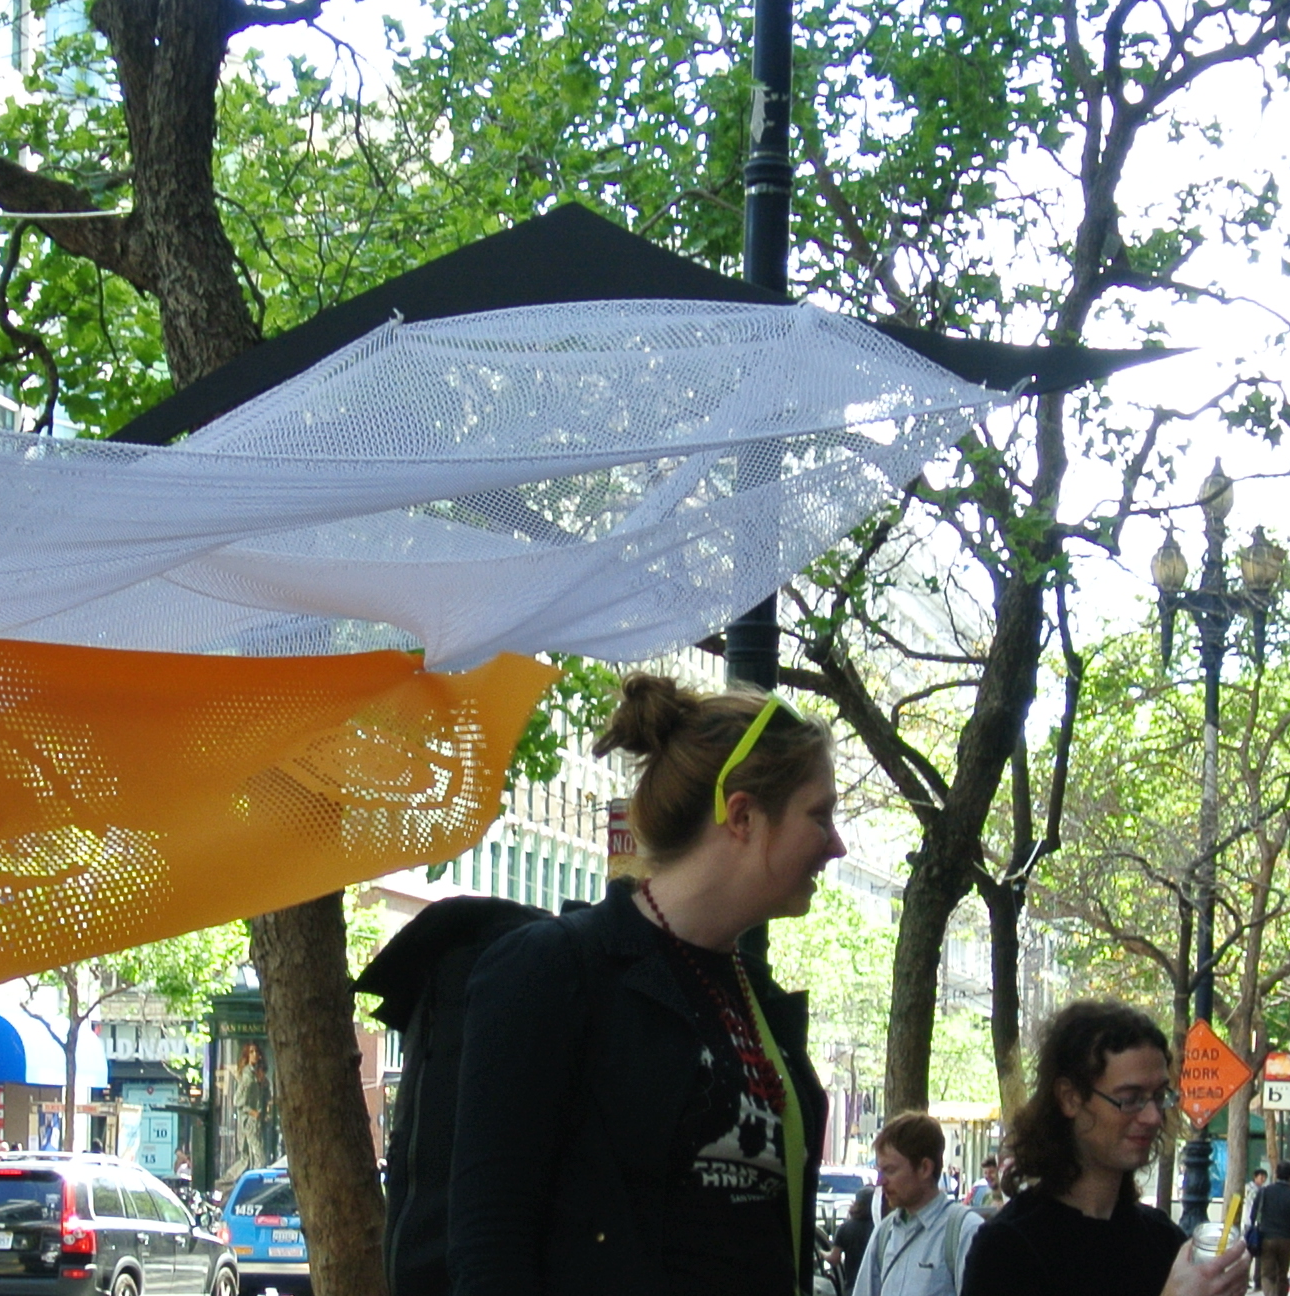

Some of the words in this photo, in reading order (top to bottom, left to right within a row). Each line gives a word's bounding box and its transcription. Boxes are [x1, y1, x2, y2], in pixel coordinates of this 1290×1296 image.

[613, 834, 633, 854] NO
[100, 1038, 134, 1062] LD
[137, 1038, 198, 1062] NAVY
[1187, 1049, 1220, 1060] OAD
[235, 1204, 263, 1216] 1457
